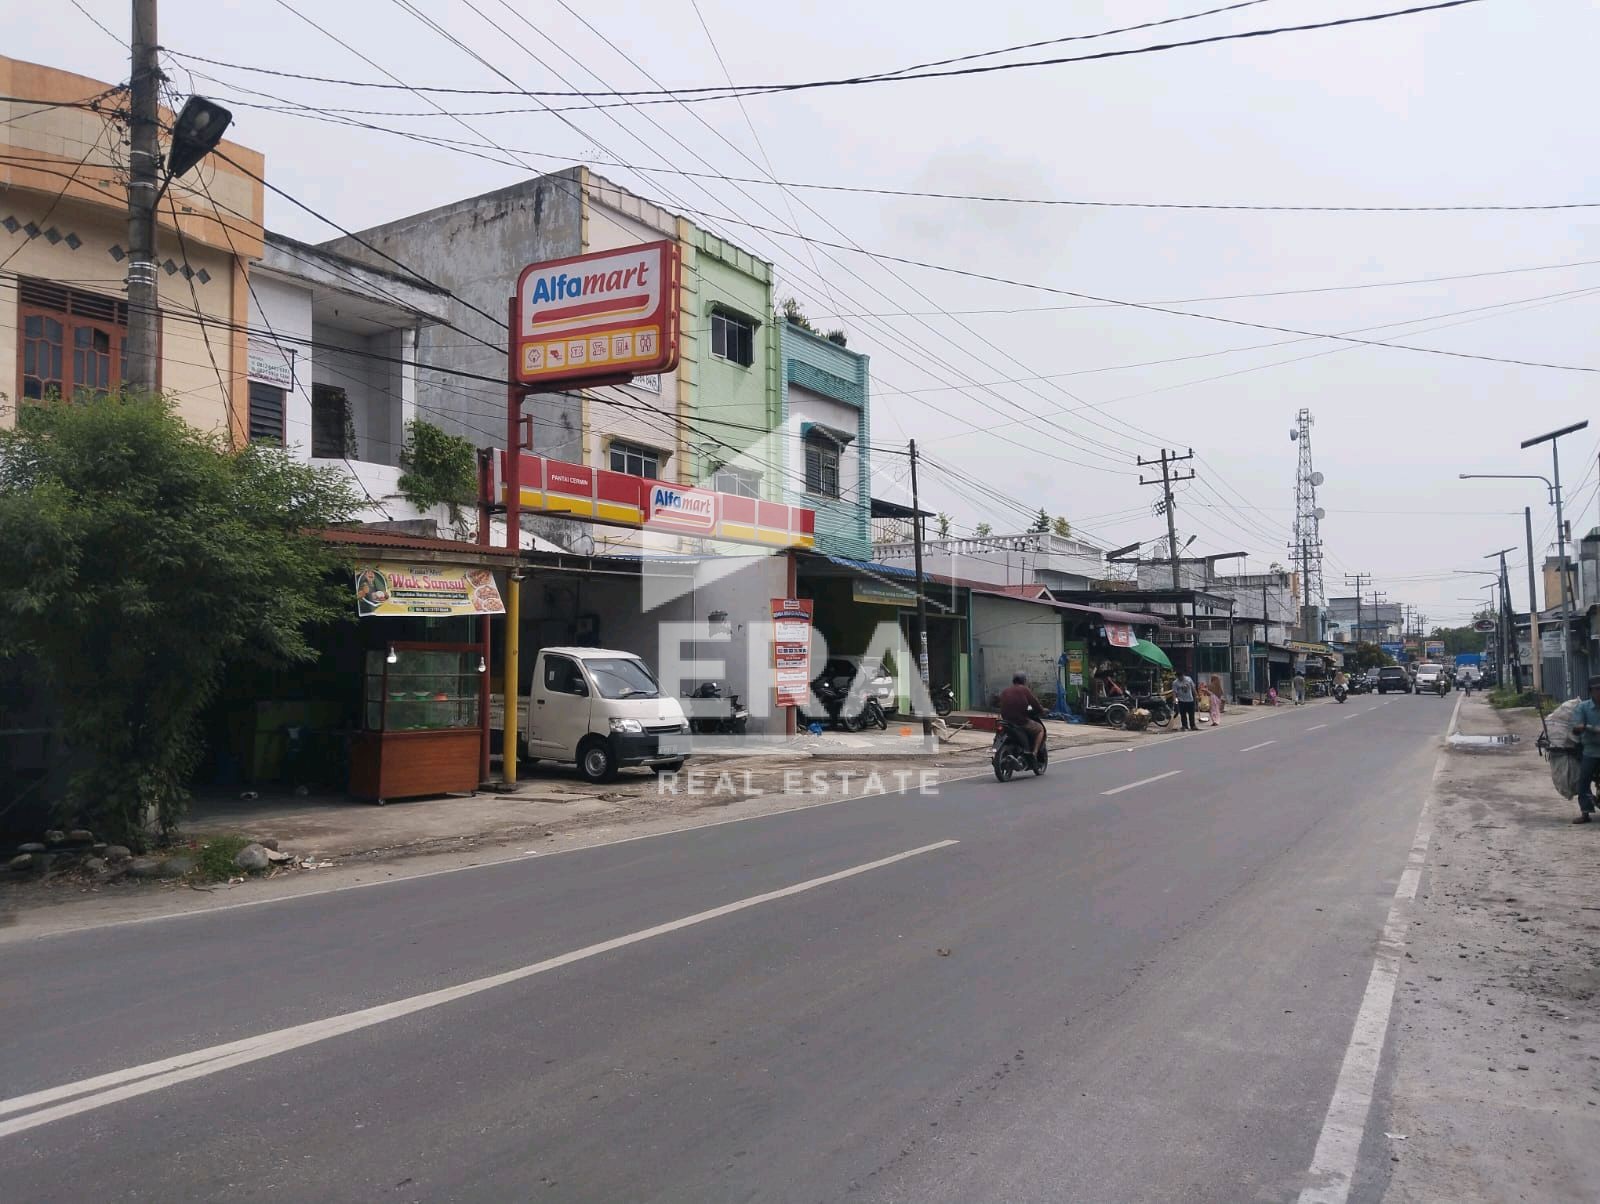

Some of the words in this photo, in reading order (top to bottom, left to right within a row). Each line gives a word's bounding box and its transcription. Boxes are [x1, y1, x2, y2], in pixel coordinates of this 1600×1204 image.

[532, 262, 649, 304] Alfamart
[551, 474, 570, 483] PANTAI
[569, 477, 589, 486] CERMIN
[655, 489, 711, 513] Alfamart
[389, 573, 421, 588] Wak
[423, 575, 465, 590] Samsul
